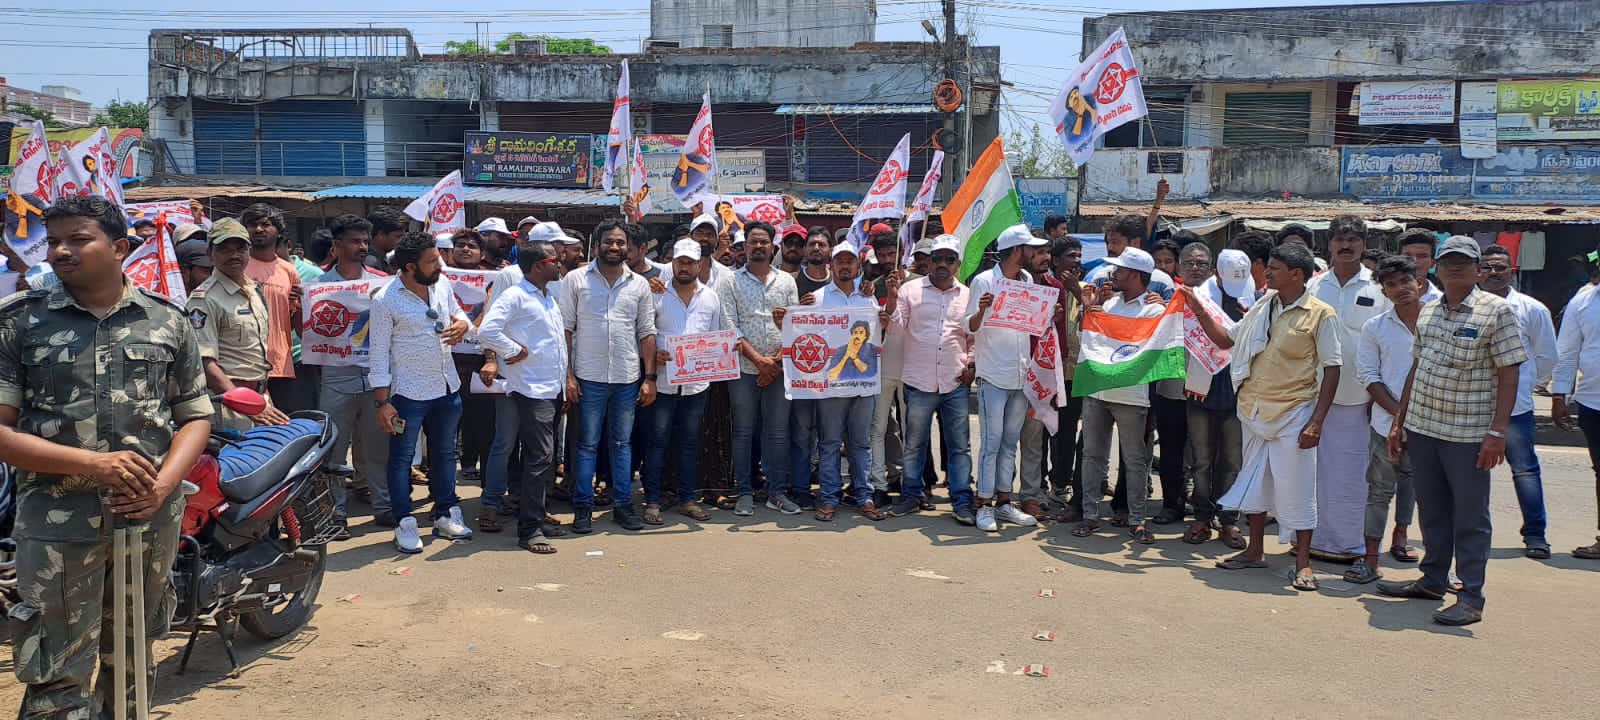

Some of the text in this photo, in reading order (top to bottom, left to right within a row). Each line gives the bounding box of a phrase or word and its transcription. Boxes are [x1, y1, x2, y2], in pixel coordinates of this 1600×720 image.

[482, 164, 572, 175] SRI RAMALINGESWARA
[791, 313, 849, 330] జనసేన పార్టీ
